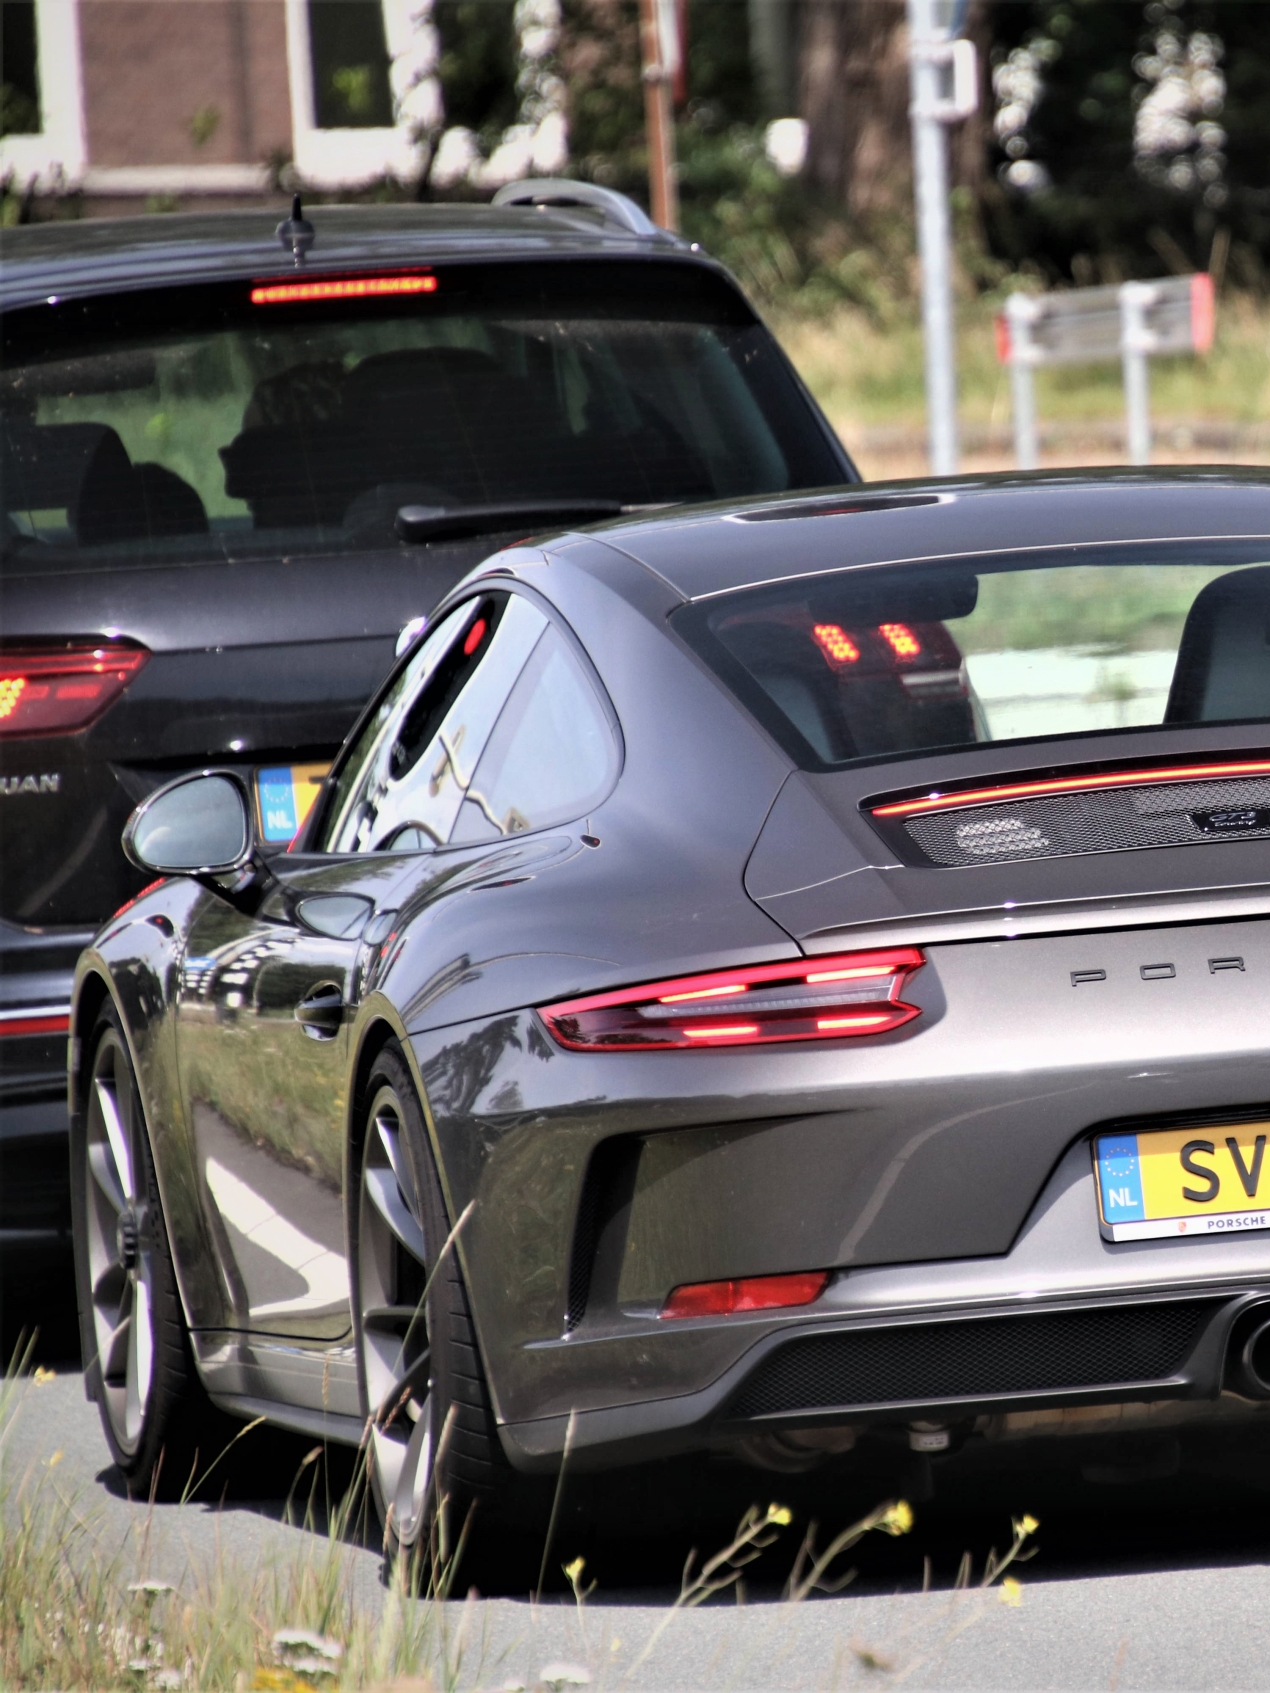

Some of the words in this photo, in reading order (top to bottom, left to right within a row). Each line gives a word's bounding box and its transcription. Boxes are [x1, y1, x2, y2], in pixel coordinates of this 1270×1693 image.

[267, 810, 293, 829] NL
[1108, 1187, 1138, 1208] NL
[1207, 1215, 1267, 1230] PORSCHE
